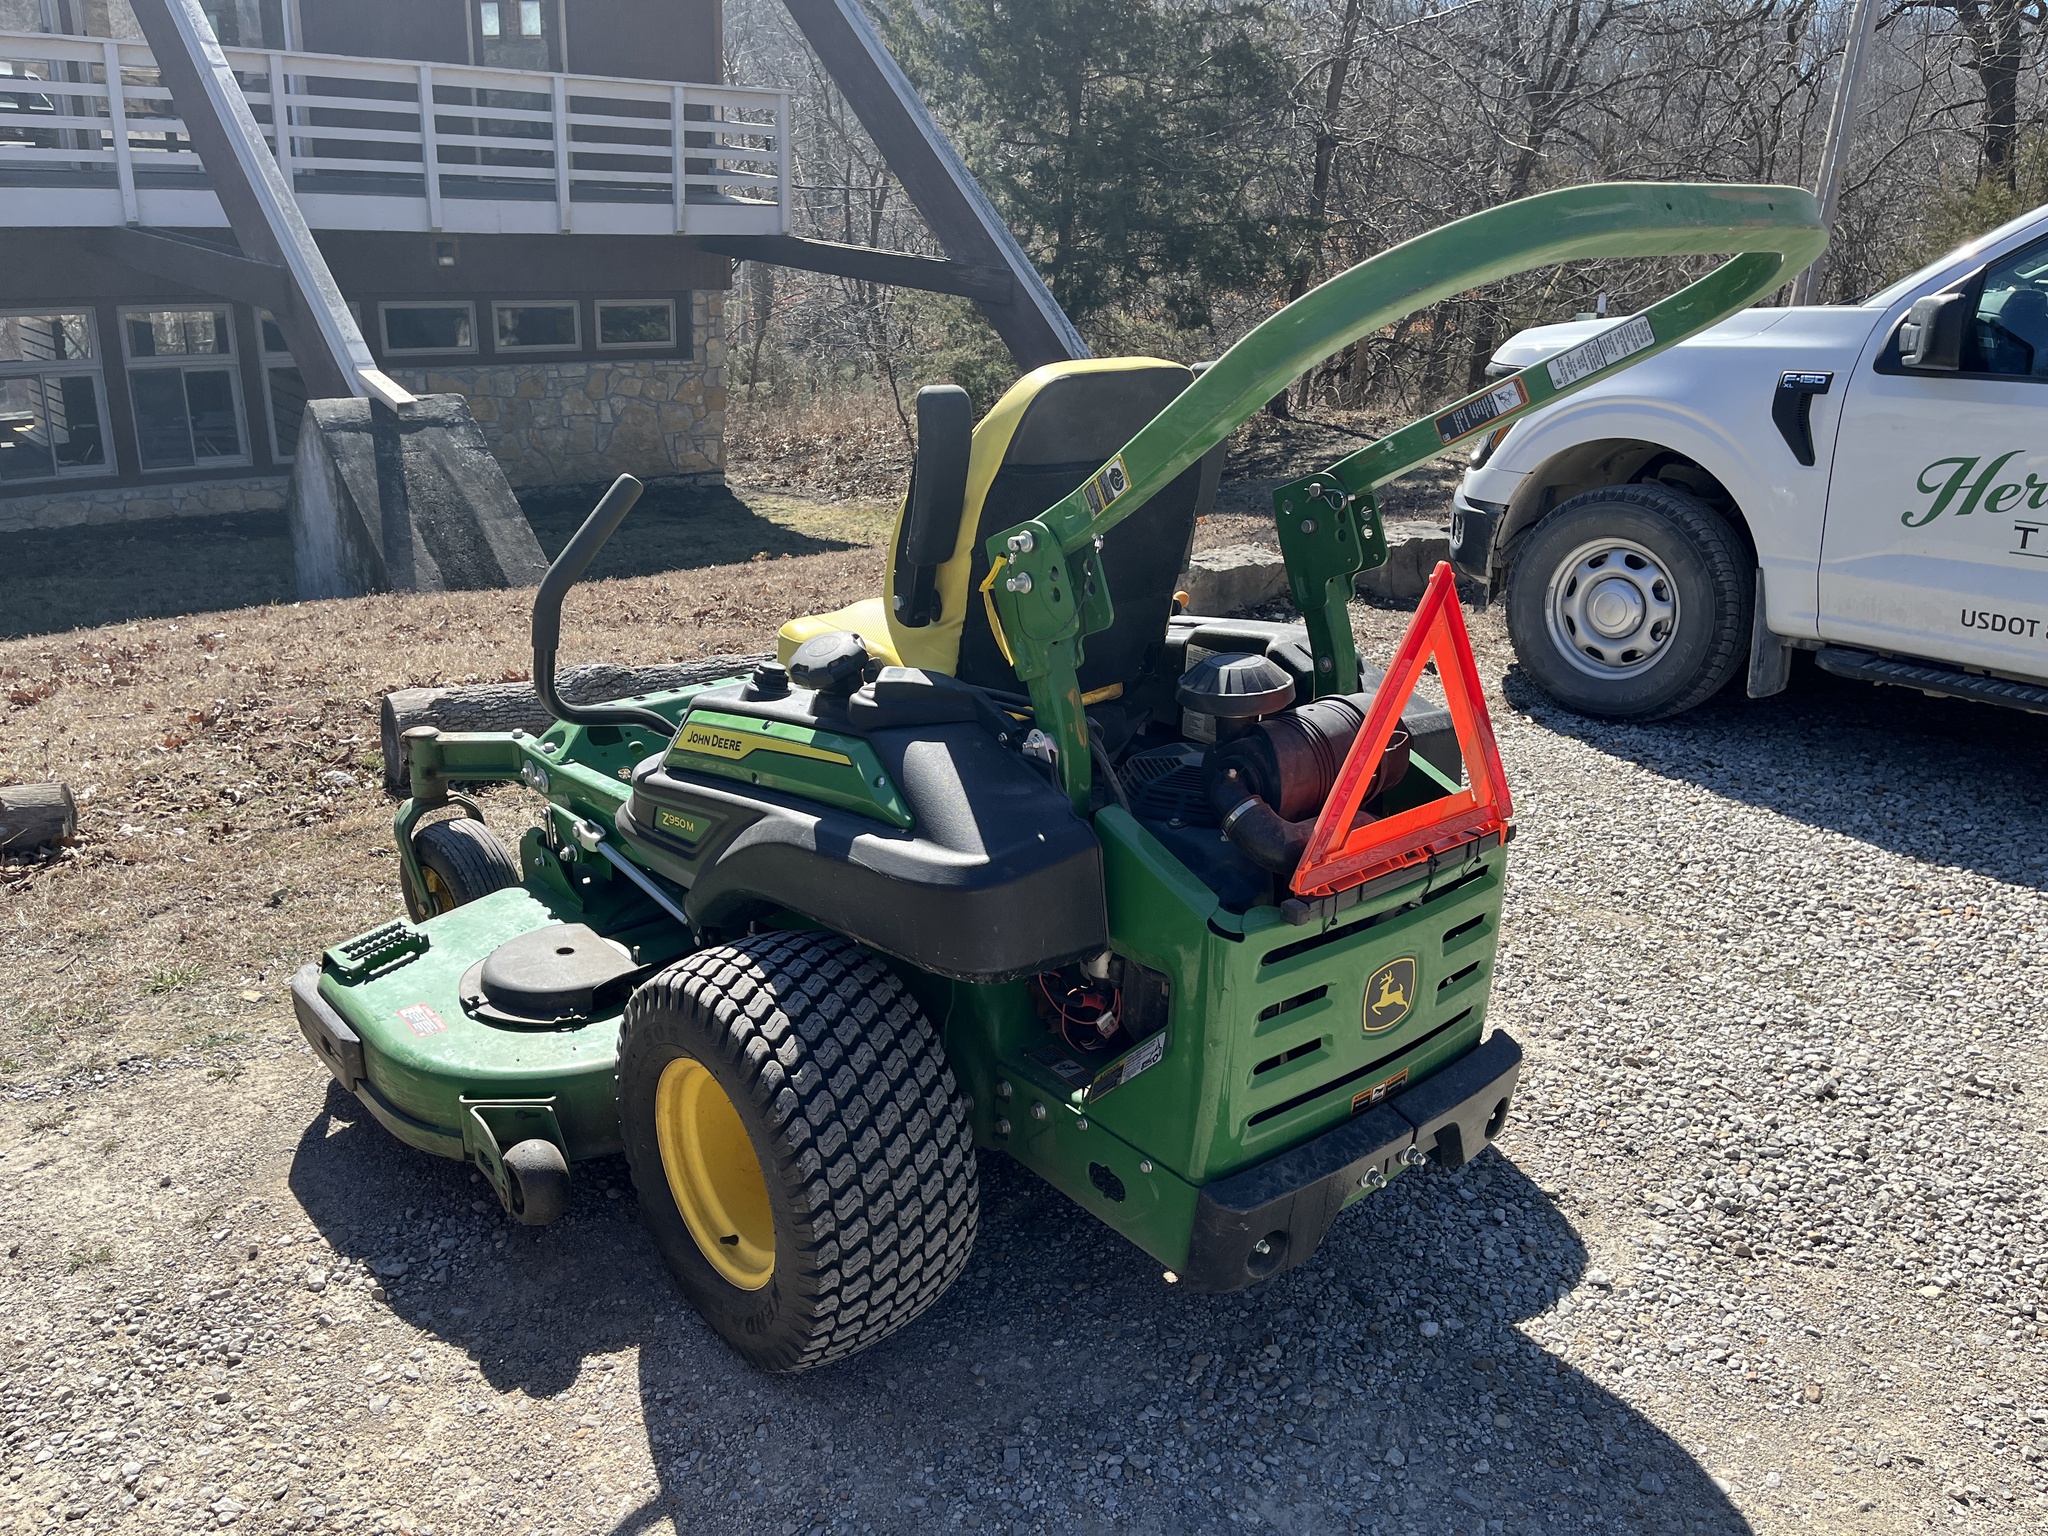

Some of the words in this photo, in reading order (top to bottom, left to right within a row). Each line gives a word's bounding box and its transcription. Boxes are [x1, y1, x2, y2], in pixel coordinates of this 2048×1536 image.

[1783, 374, 1827, 384] F-150
[1961, 608, 2041, 638] USDOT
[687, 730, 711, 746] JOHN
[711, 734, 742, 752] DEERE
